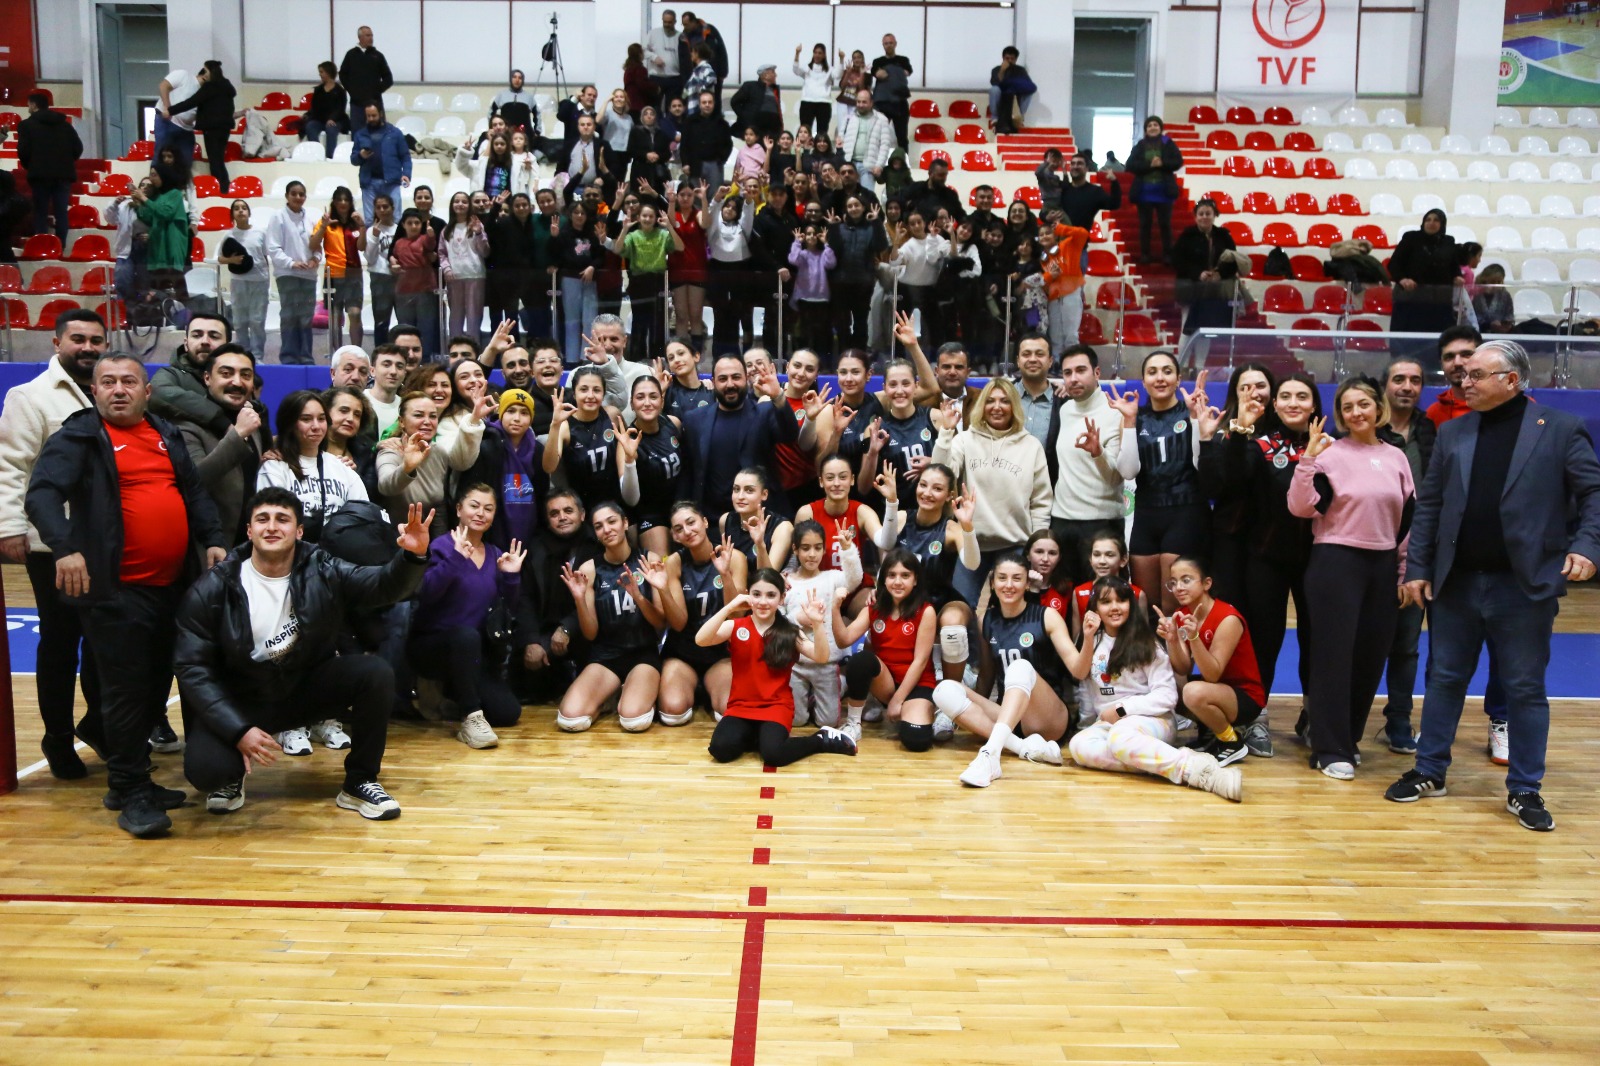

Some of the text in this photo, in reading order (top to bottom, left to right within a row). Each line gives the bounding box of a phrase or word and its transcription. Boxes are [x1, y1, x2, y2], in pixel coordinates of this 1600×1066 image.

[1257, 57, 1316, 85] TVF
[515, 393, 527, 402] NY
[587, 445, 608, 473] 17
[1157, 436, 1167, 463] 1
[661, 452, 681, 479] 12
[611, 589, 636, 615] 14
[696, 592, 709, 616] 7
